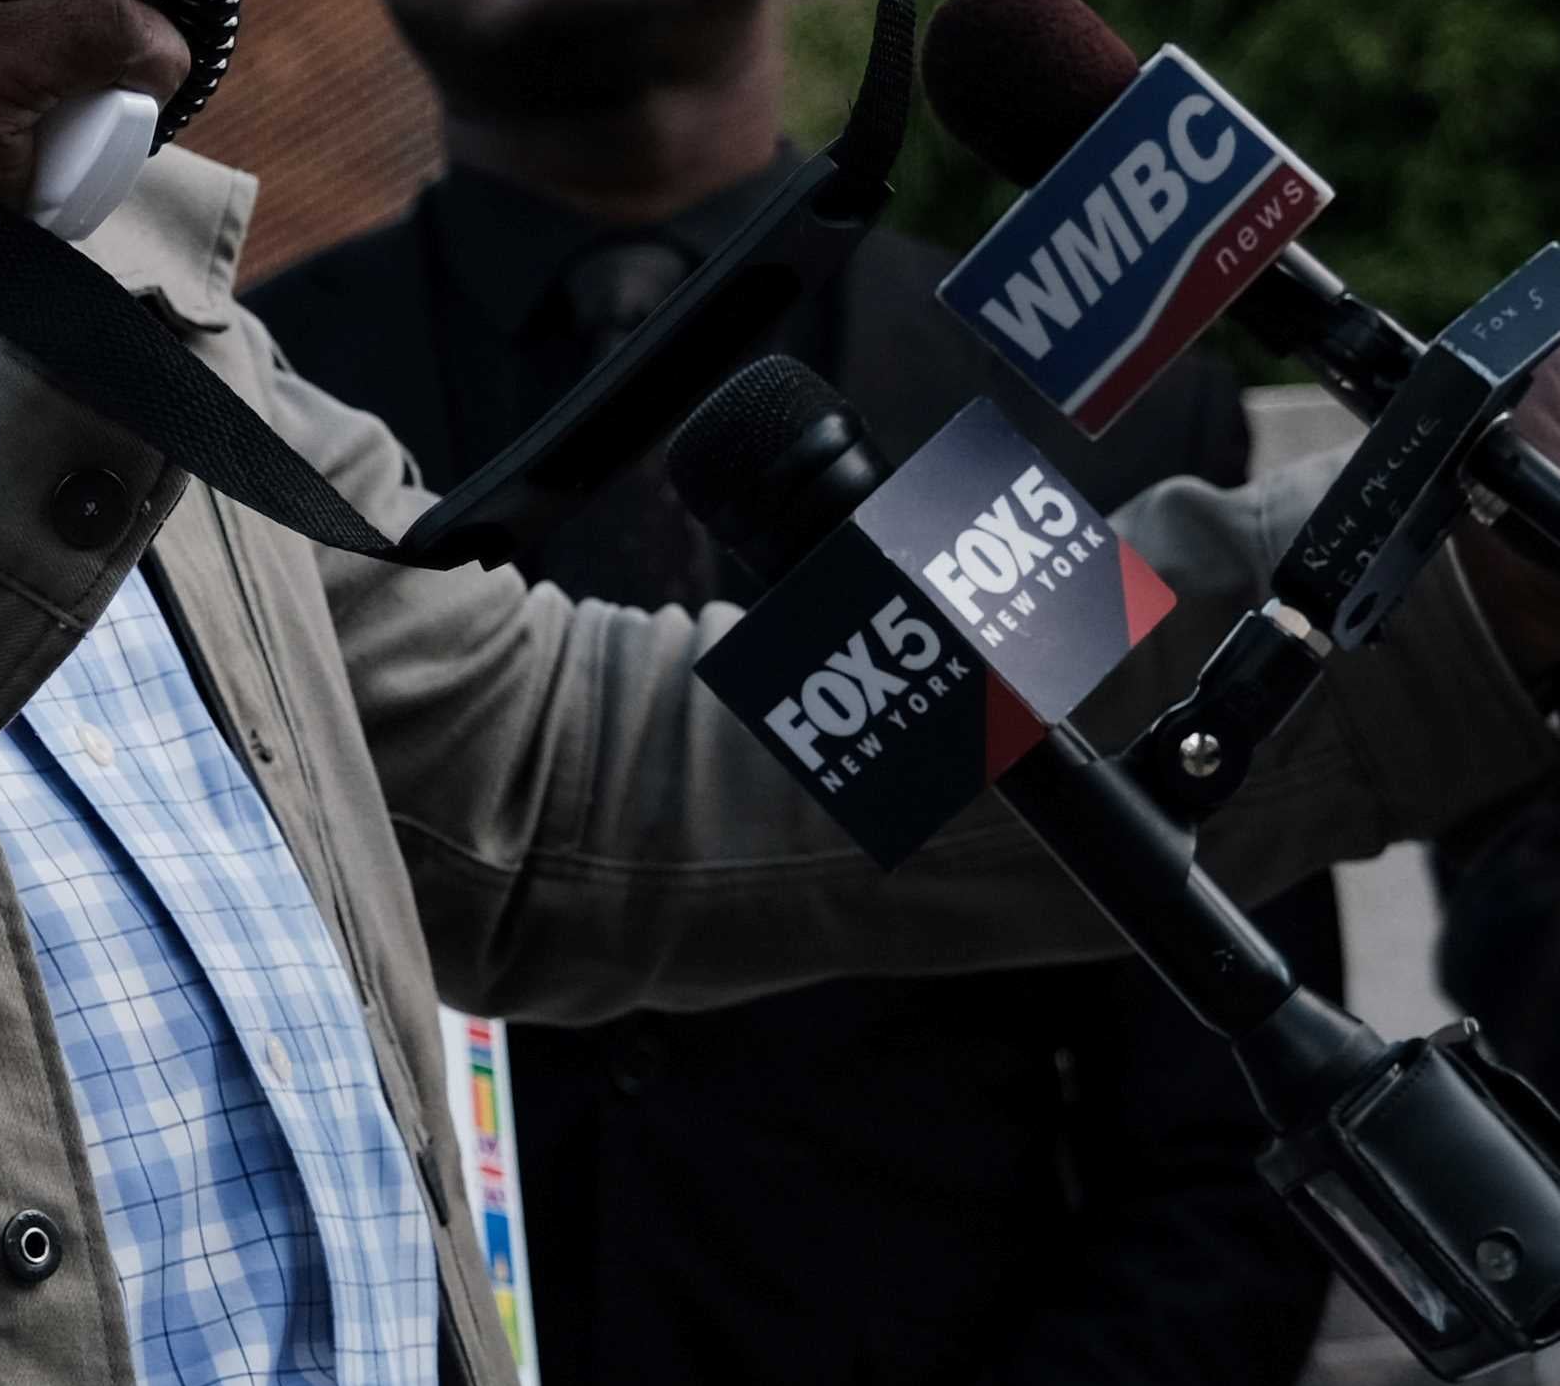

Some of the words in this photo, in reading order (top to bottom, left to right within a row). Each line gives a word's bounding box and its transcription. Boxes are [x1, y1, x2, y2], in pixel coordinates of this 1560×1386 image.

[980, 94, 1237, 361] WMBC
[1215, 179, 1305, 274] news
[981, 591, 1037, 647] NEW
[1036, 525, 1106, 592] YORK
[820, 733, 883, 793] NEW
[889, 657, 971, 730] YORK
